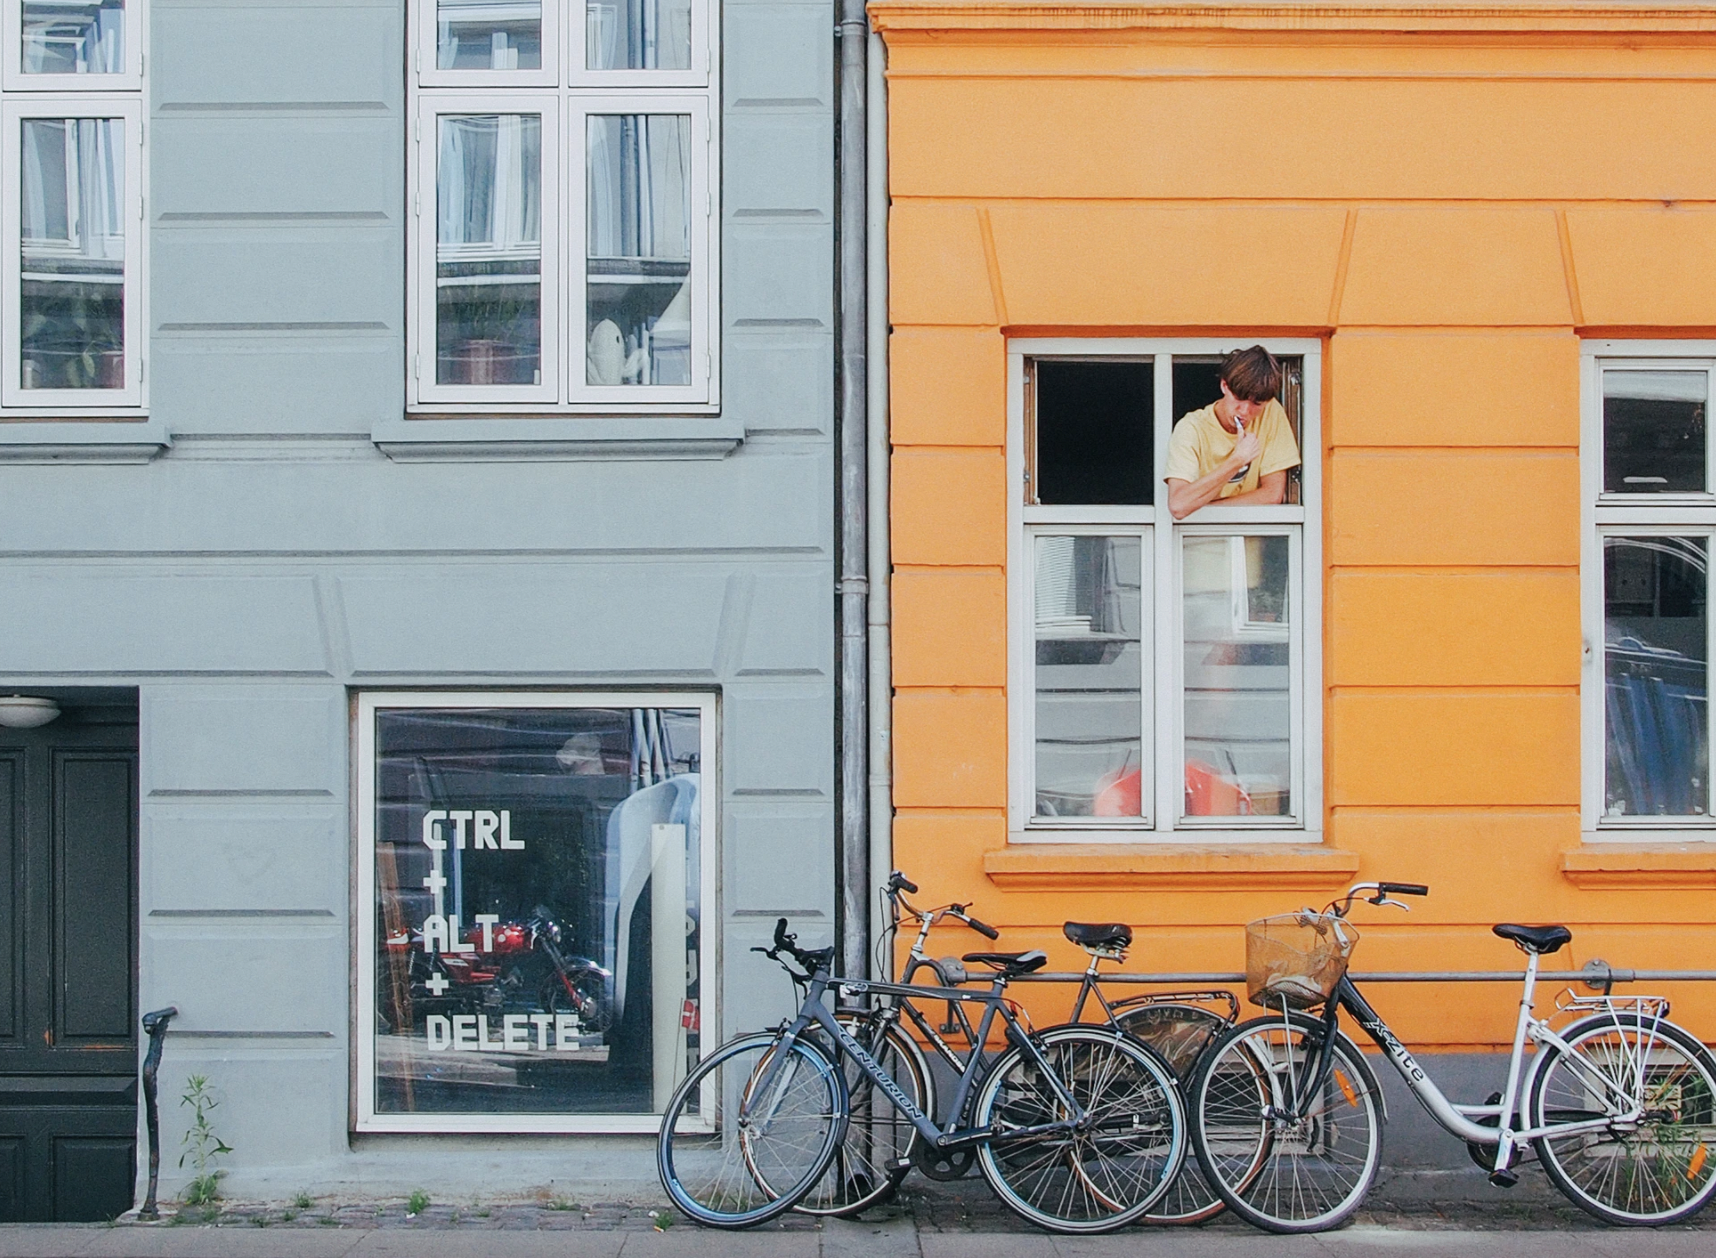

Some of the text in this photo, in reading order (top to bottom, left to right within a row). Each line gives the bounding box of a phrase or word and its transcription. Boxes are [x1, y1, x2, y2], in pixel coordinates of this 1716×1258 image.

[422, 810, 525, 850] CTRL
[422, 870, 447, 894] +
[424, 914, 499, 953] ALT
[425, 972, 449, 996] +
[426, 1014, 580, 1051] DELETE
[838, 1030, 923, 1120] CENTURION
